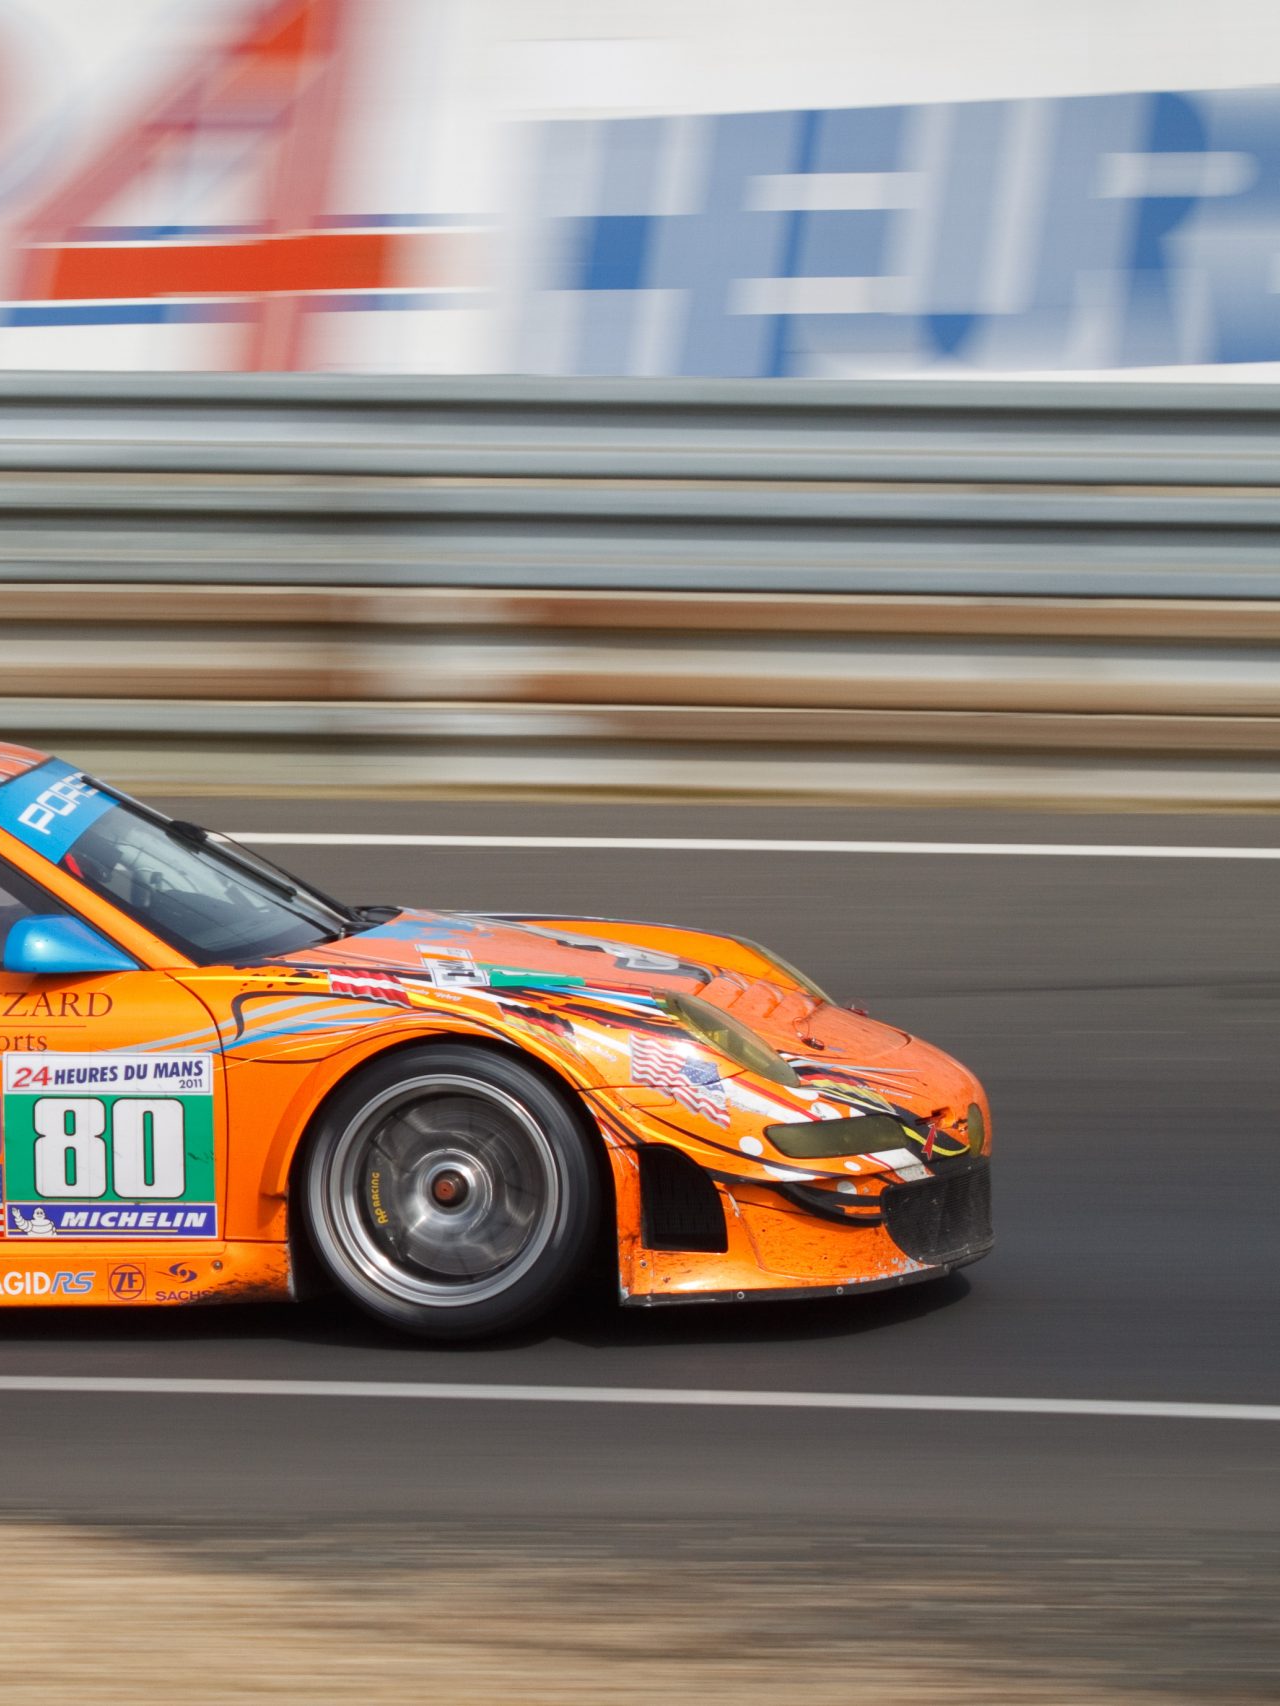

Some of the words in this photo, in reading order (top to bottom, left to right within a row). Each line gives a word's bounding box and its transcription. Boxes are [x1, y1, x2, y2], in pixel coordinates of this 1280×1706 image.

[505, 85, 1280, 379] HEUR
[12, 1065, 52, 1088] 24
[54, 1066, 118, 1085] HEURES
[124, 1064, 148, 1081] DU
[153, 1060, 204, 1079] MANS
[179, 1078, 203, 1089] 2011
[33, 1096, 186, 1199] 80
[60, 1211, 208, 1228] MICHELIN
